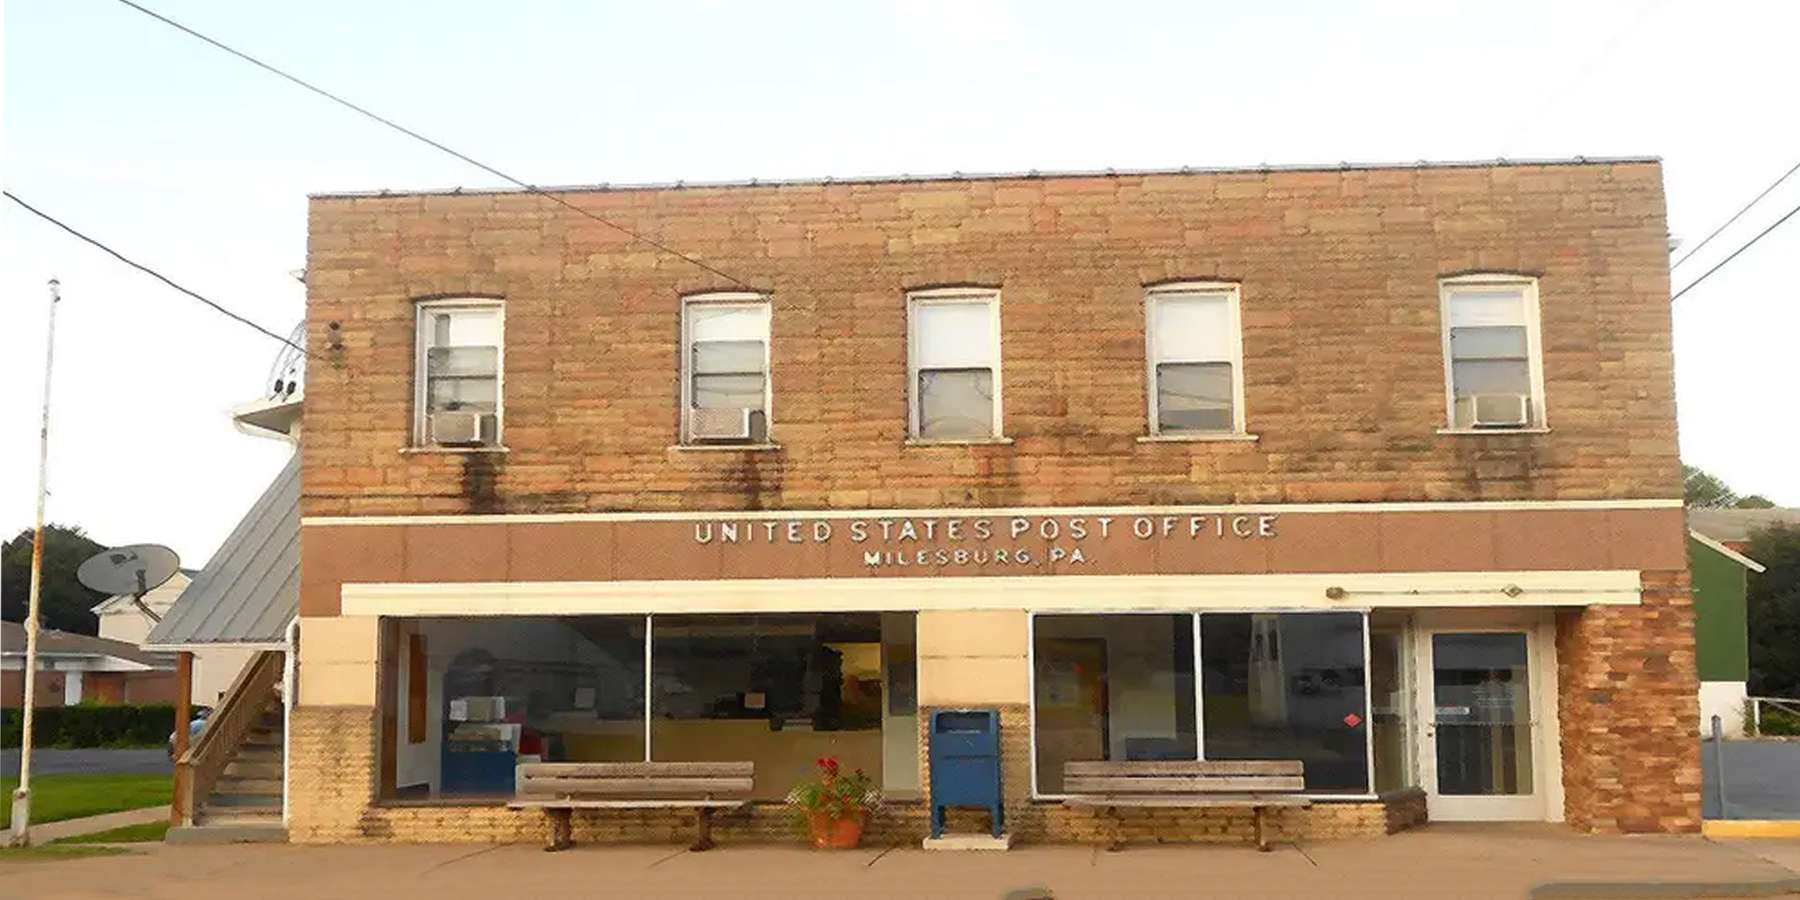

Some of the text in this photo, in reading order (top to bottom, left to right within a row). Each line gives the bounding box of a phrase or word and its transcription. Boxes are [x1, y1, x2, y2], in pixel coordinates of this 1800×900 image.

[695, 515, 1278, 543] UNITED STATES POST OFFICE
